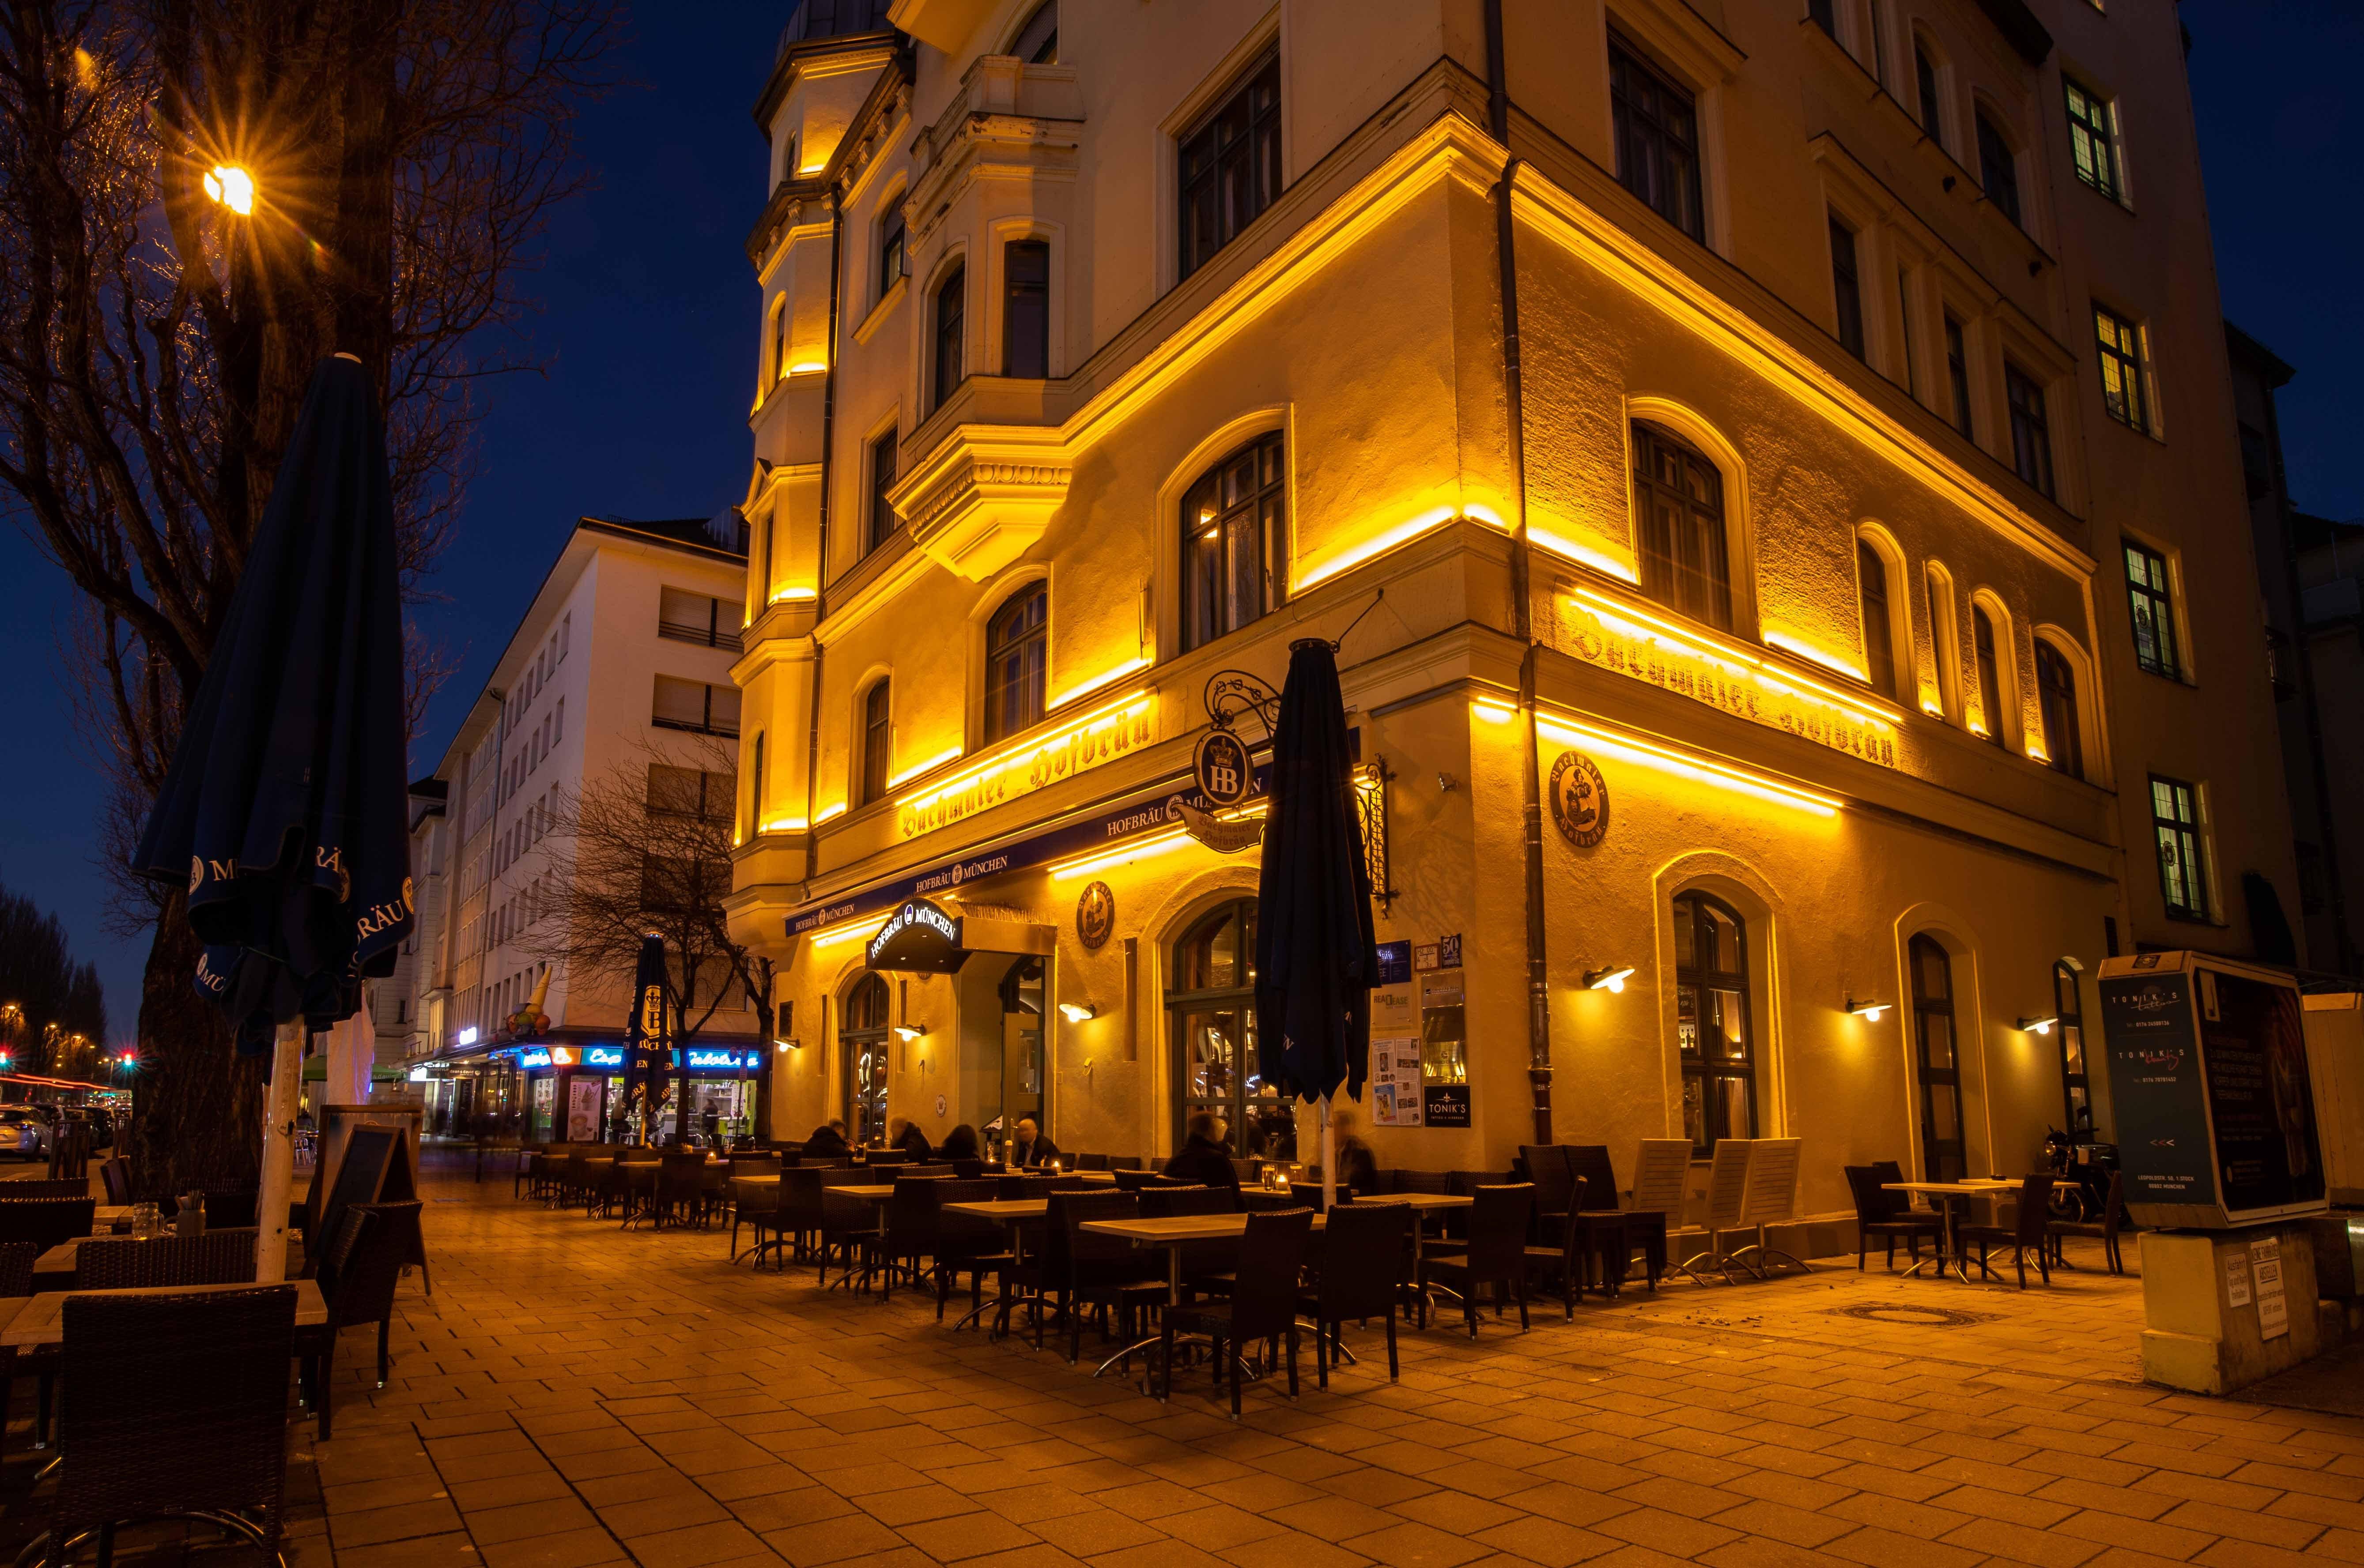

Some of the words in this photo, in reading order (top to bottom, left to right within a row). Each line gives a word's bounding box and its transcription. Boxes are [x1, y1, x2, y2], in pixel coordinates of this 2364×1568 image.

[1210, 765, 1238, 794] HB
[1107, 807, 1163, 837] HOFBRÄU
[916, 872, 951, 893] HOFBRÄU
[963, 856, 1008, 879] MÜNCHEN
[356, 899, 404, 946] RÄU
[796, 915, 818, 931] HOFBRÄU
[825, 904, 854, 921] MÜNCHEN
[871, 915, 902, 958] HOFBRÄU
[915, 907, 956, 941] MÜNCHEN
[1443, 937, 1459, 954] 50
[2112, 992, 2177, 1003] TONIK'S
[2119, 1049, 2184, 1060] TONIK'S
[1429, 1104, 1465, 1113] TONIK'S
